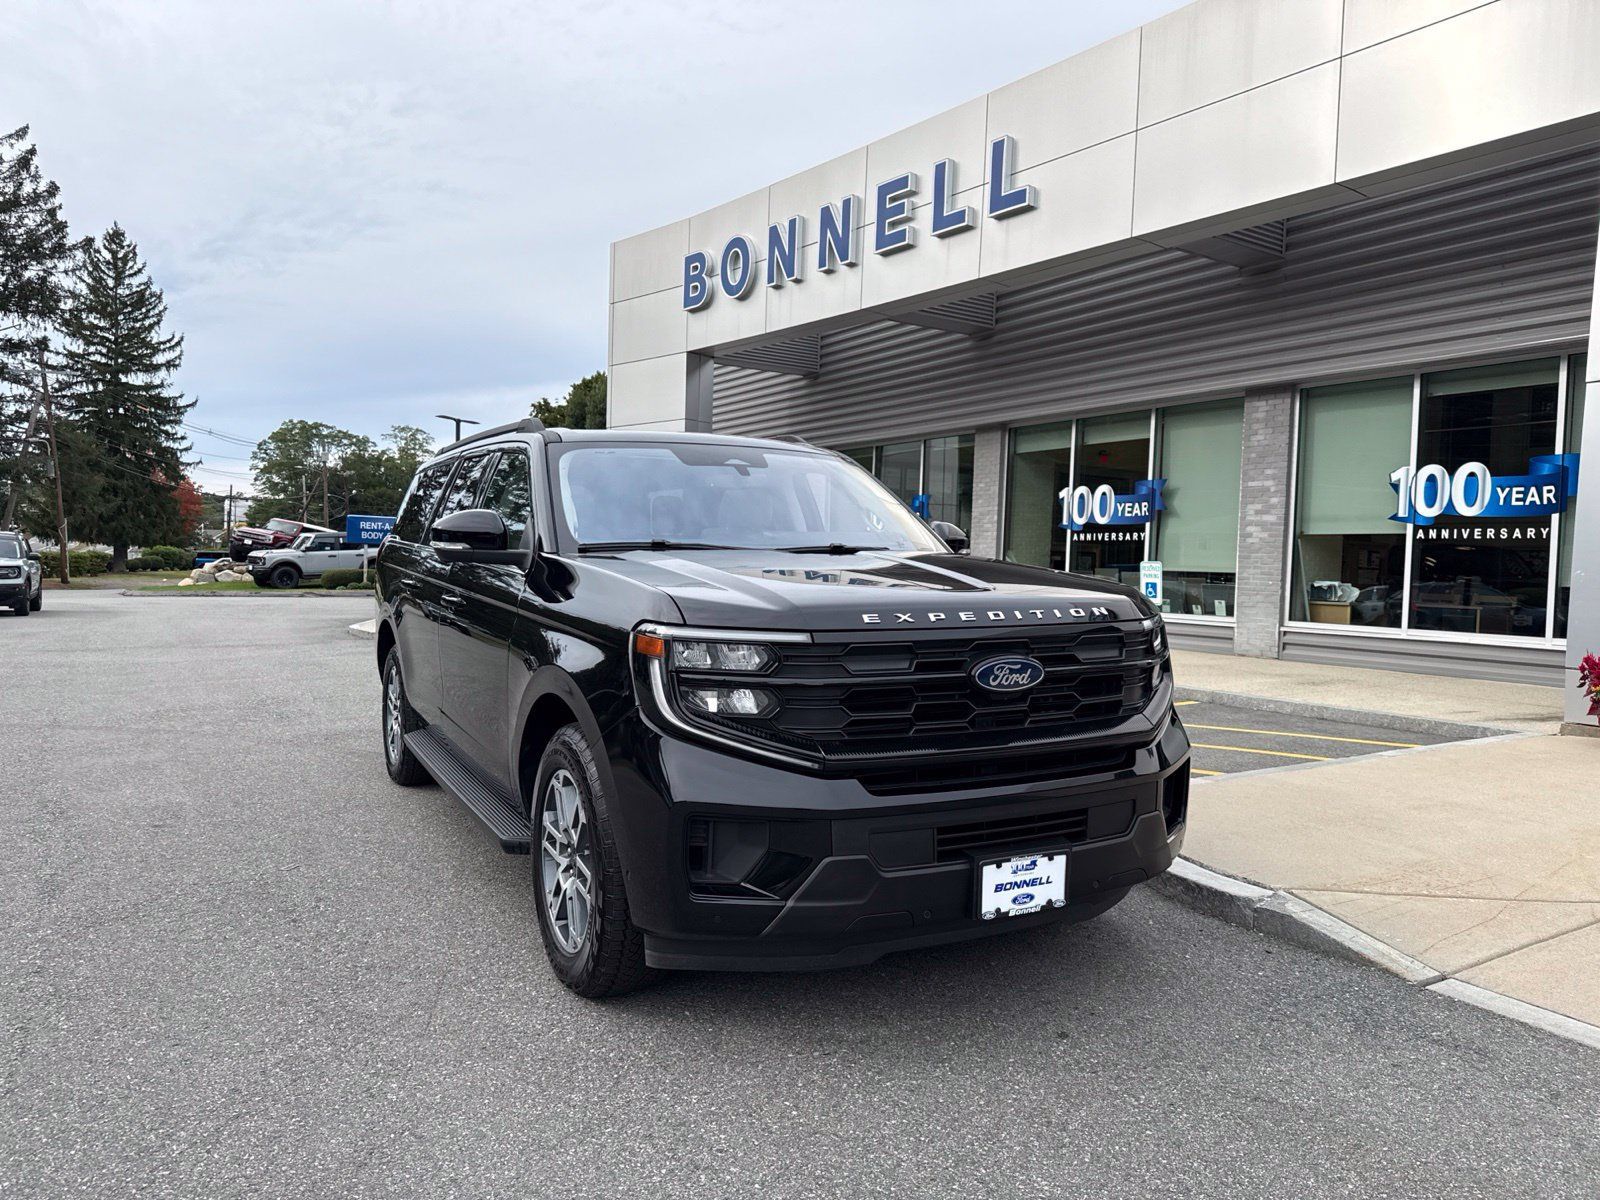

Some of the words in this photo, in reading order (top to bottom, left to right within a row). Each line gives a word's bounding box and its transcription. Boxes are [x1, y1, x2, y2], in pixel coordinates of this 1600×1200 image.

[683, 134, 1037, 313] BONNELL
[1389, 462, 1492, 517] 100
[1496, 485, 1556, 506] YEAR
[1059, 484, 1115, 525] 100
[1117, 502, 1149, 517] YEAR
[361, 531, 384, 539] BODY
[1073, 532, 1146, 541] ANNIVERSARY
[1416, 527, 1550, 540] ANNIVERSARY
[862, 606, 1109, 624] EXPEDITION
[989, 664, 1031, 686] Ford
[994, 876, 1053, 893] BONNELL
[1009, 904, 1041, 917] Bonnell
